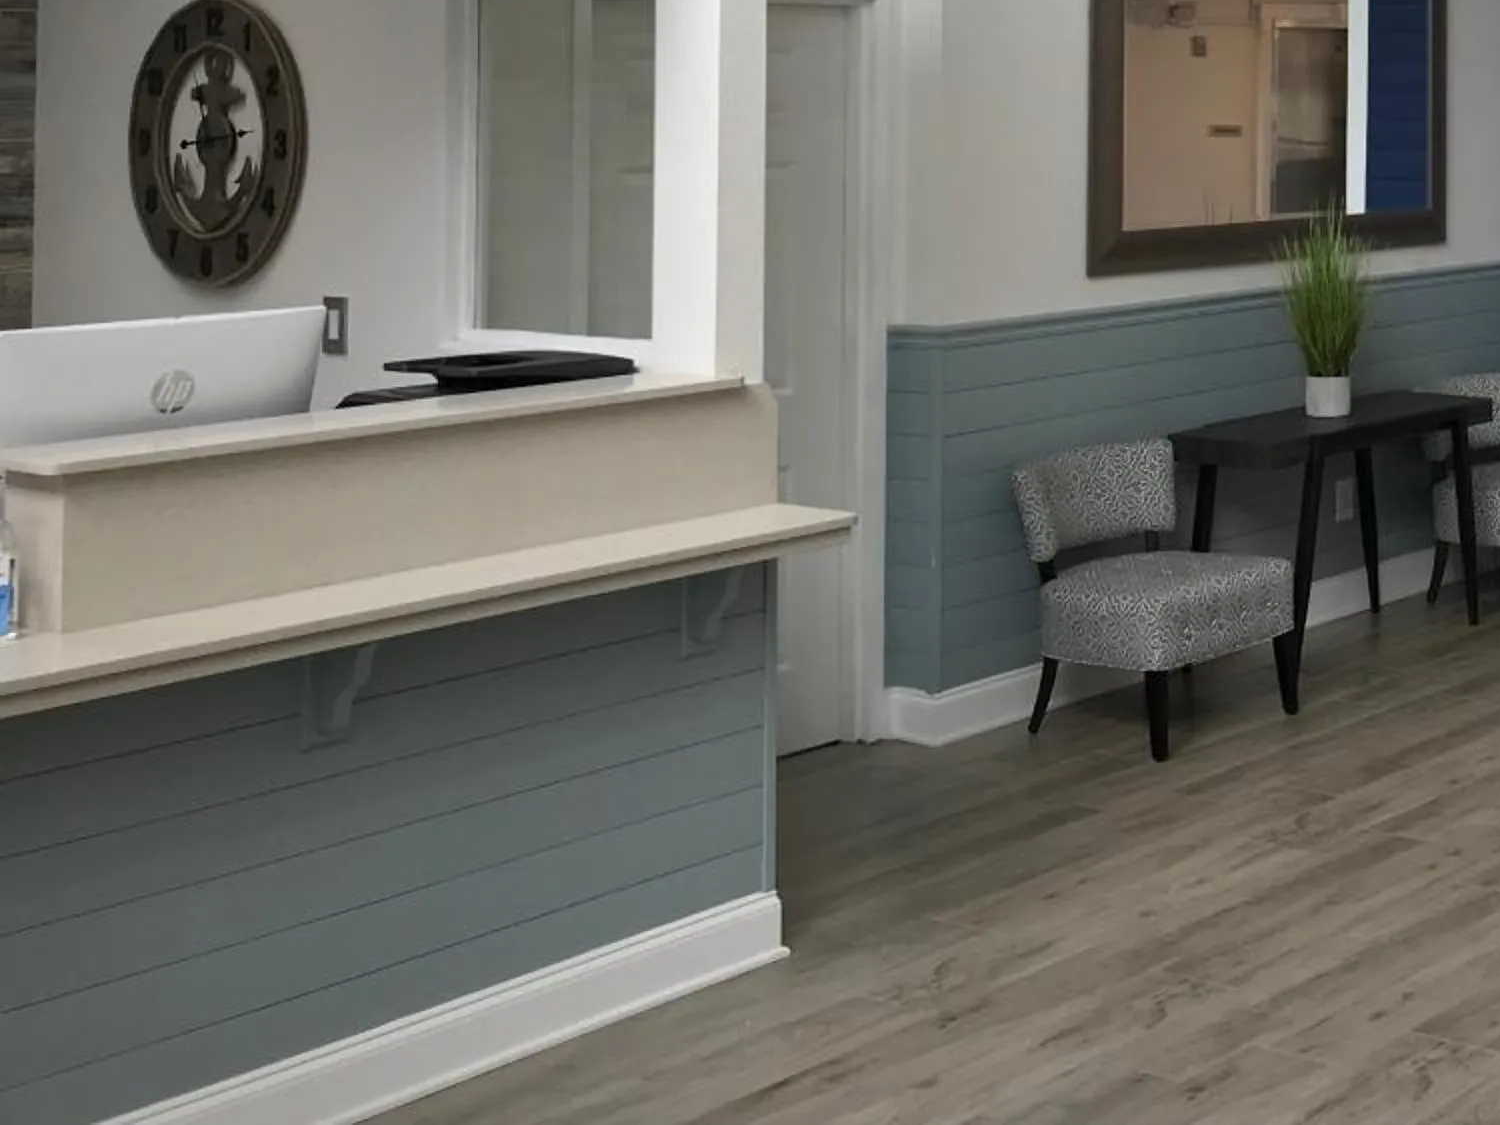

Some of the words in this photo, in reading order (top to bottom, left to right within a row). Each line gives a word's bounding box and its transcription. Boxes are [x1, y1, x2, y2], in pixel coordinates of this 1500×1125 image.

[205, 7, 225, 37] 12
[265, 66, 281, 97] 2
[274, 129, 287, 159] 3
[261, 187, 275, 217] 4
[235, 232, 249, 263] 5
[156, 371, 193, 414] hp
